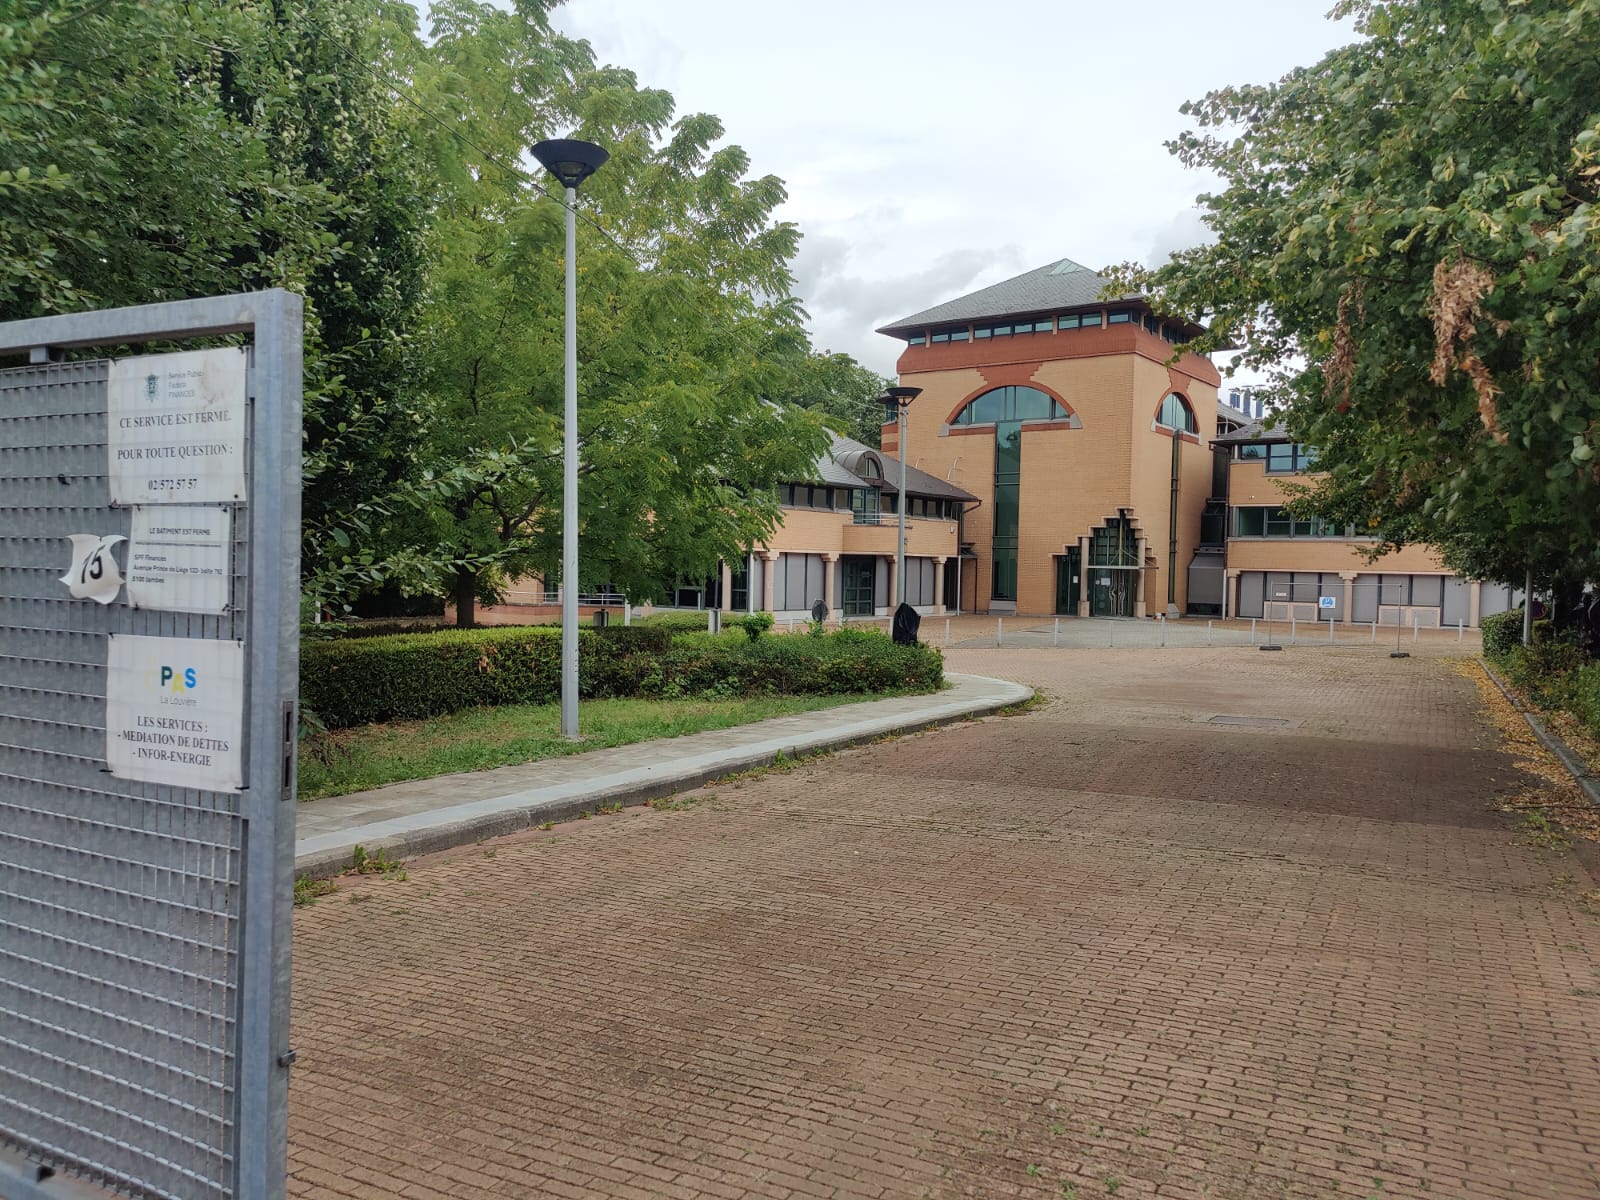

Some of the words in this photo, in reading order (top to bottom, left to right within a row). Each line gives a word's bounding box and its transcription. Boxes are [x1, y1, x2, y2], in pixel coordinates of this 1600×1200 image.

[120, 417, 132, 429] CE
[133, 414, 173, 428] SERVICE
[176, 413, 193, 425] EST
[118, 448, 143, 460] POUR
[145, 446, 176, 458] TOUTE
[178, 444, 228, 460] QUESTION
[81, 544, 106, 584] 15
[137, 715, 155, 728] LES
[157, 717, 203, 732] SERVICES
[122, 730, 176, 746] MEDIATION
[178, 735, 191, 747] DE
[193, 737, 230, 752] DETTES
[138, 747, 212, 767] INFOR-ENERGIE
